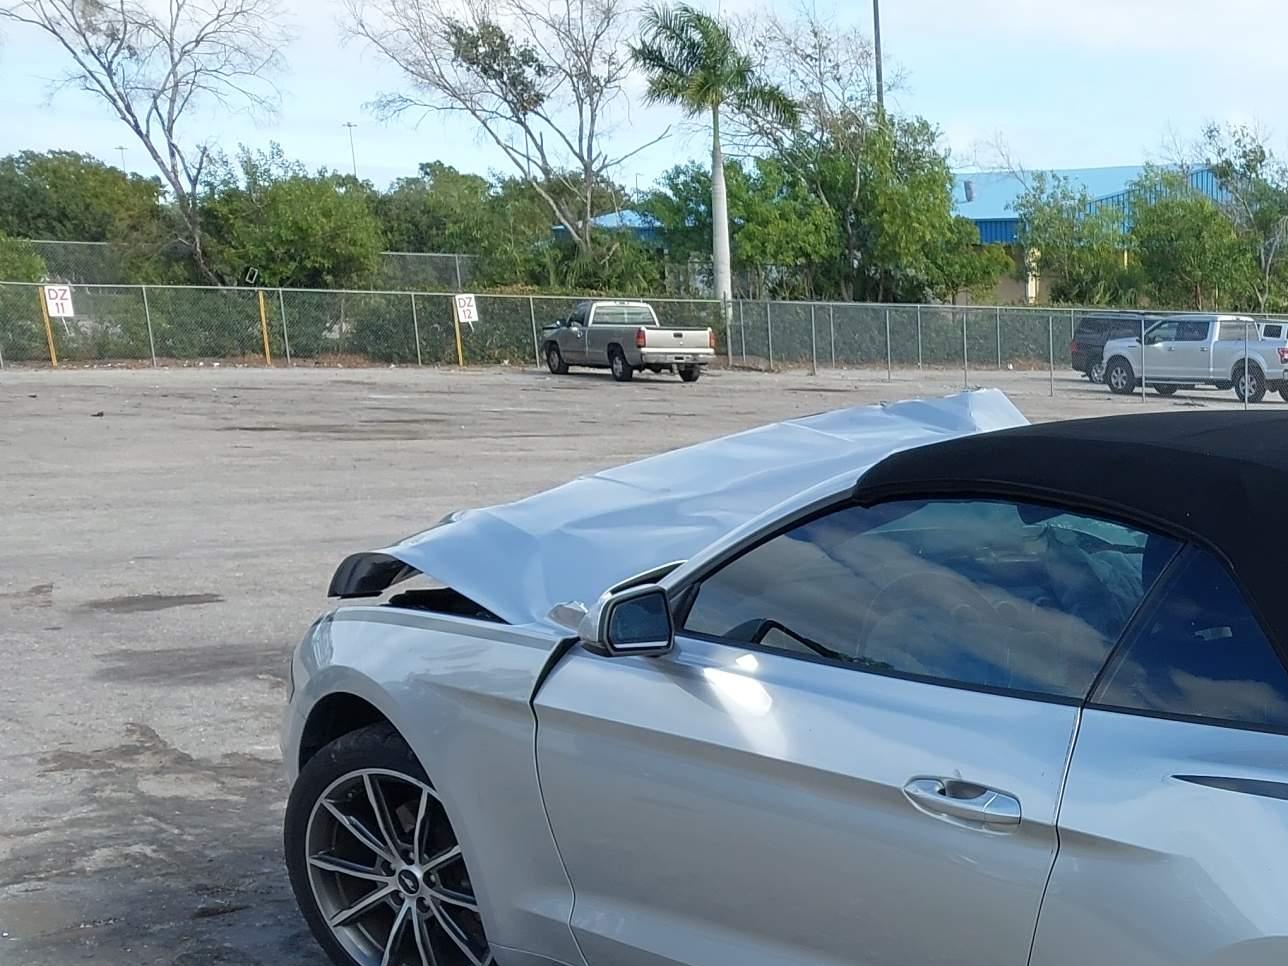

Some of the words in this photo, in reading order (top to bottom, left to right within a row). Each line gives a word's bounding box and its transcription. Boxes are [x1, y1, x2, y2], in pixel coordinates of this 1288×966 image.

[47, 288, 70, 301] DZ
[55, 302, 65, 314] 11
[457, 296, 474, 309] DZ
[462, 308, 473, 320] 12
